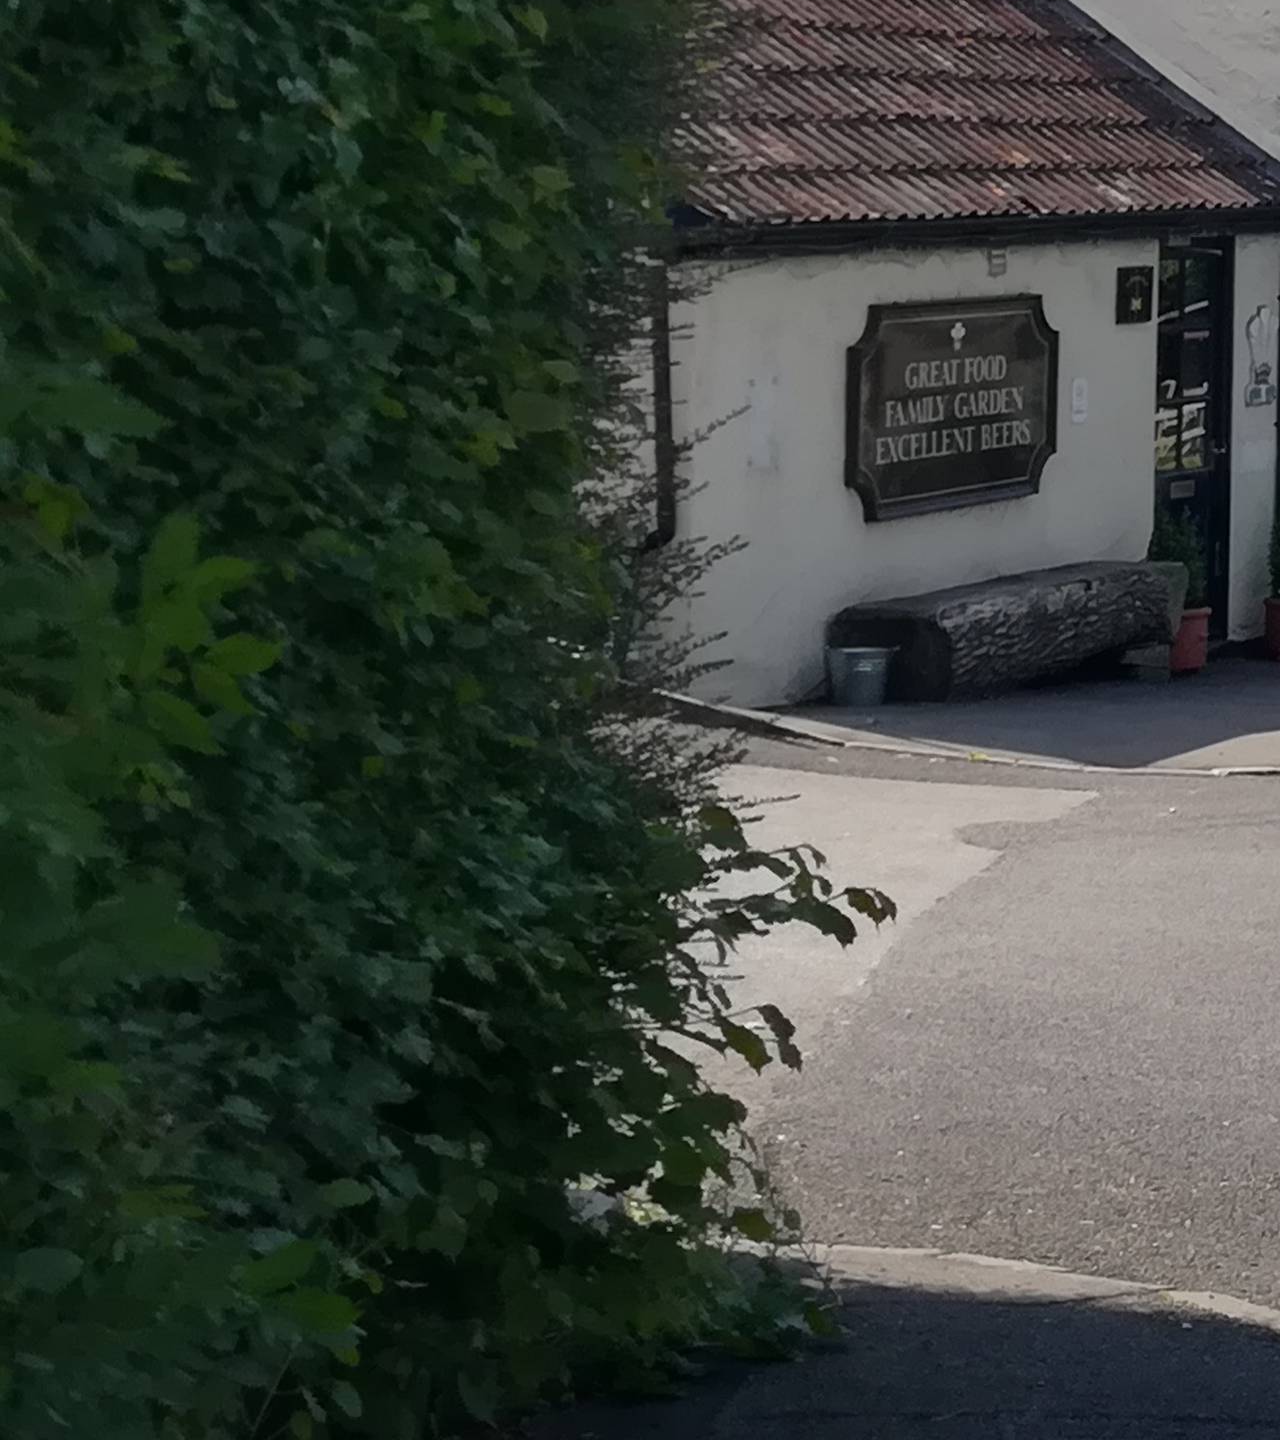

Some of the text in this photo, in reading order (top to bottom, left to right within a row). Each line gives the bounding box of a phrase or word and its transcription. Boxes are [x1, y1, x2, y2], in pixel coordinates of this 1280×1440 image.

[904, 355, 1007, 389] GREAT FOOD
[885, 387, 1024, 428] FAMILY GARDEN
[875, 420, 1031, 465] EXCELLENT BEERS
